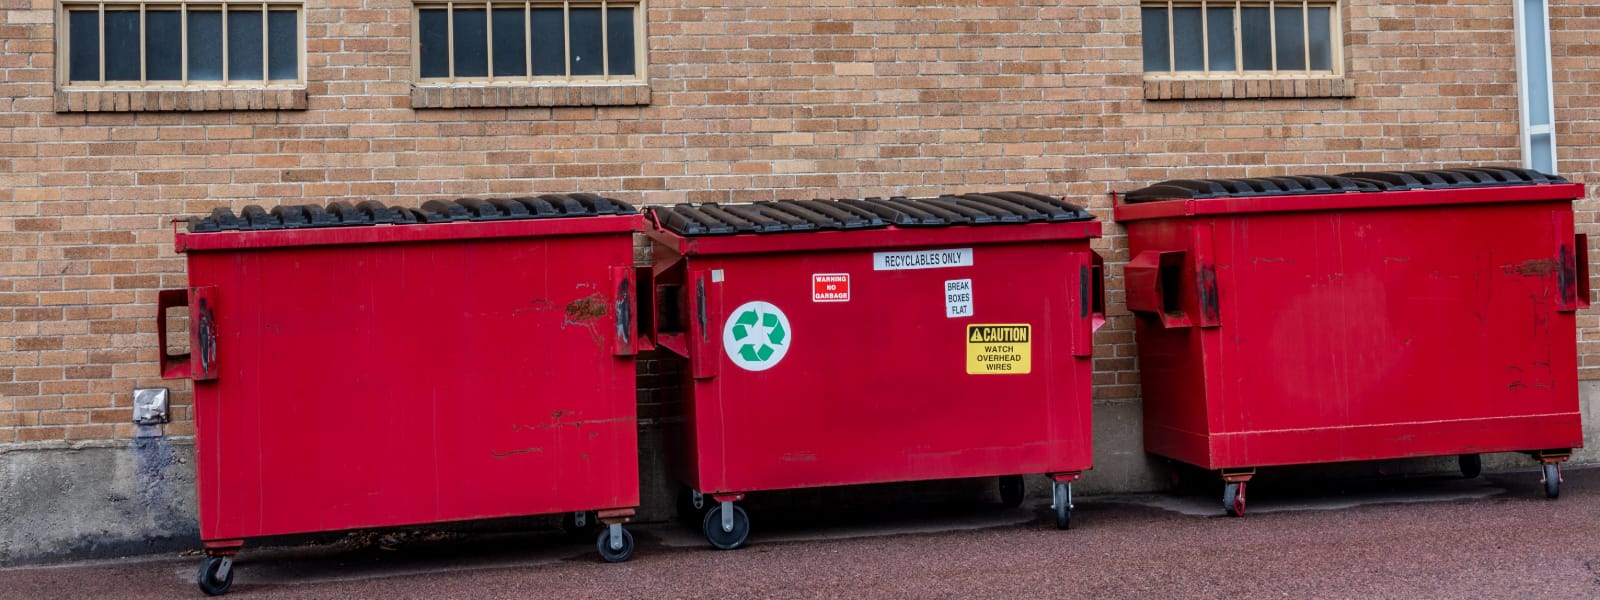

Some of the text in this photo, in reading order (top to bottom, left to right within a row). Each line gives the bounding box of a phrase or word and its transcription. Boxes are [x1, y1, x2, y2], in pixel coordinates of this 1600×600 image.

[885, 251, 962, 267] RECYCLABLES ONLY
[947, 281, 969, 291] BREAK
[948, 293, 970, 303] BOXES
[952, 305, 967, 315] FLAT
[983, 327, 1027, 342] CAUTION
[984, 345, 1014, 353] WATCH
[976, 354, 1022, 362] OVERHEAD
[986, 363, 1012, 371] WIRES
